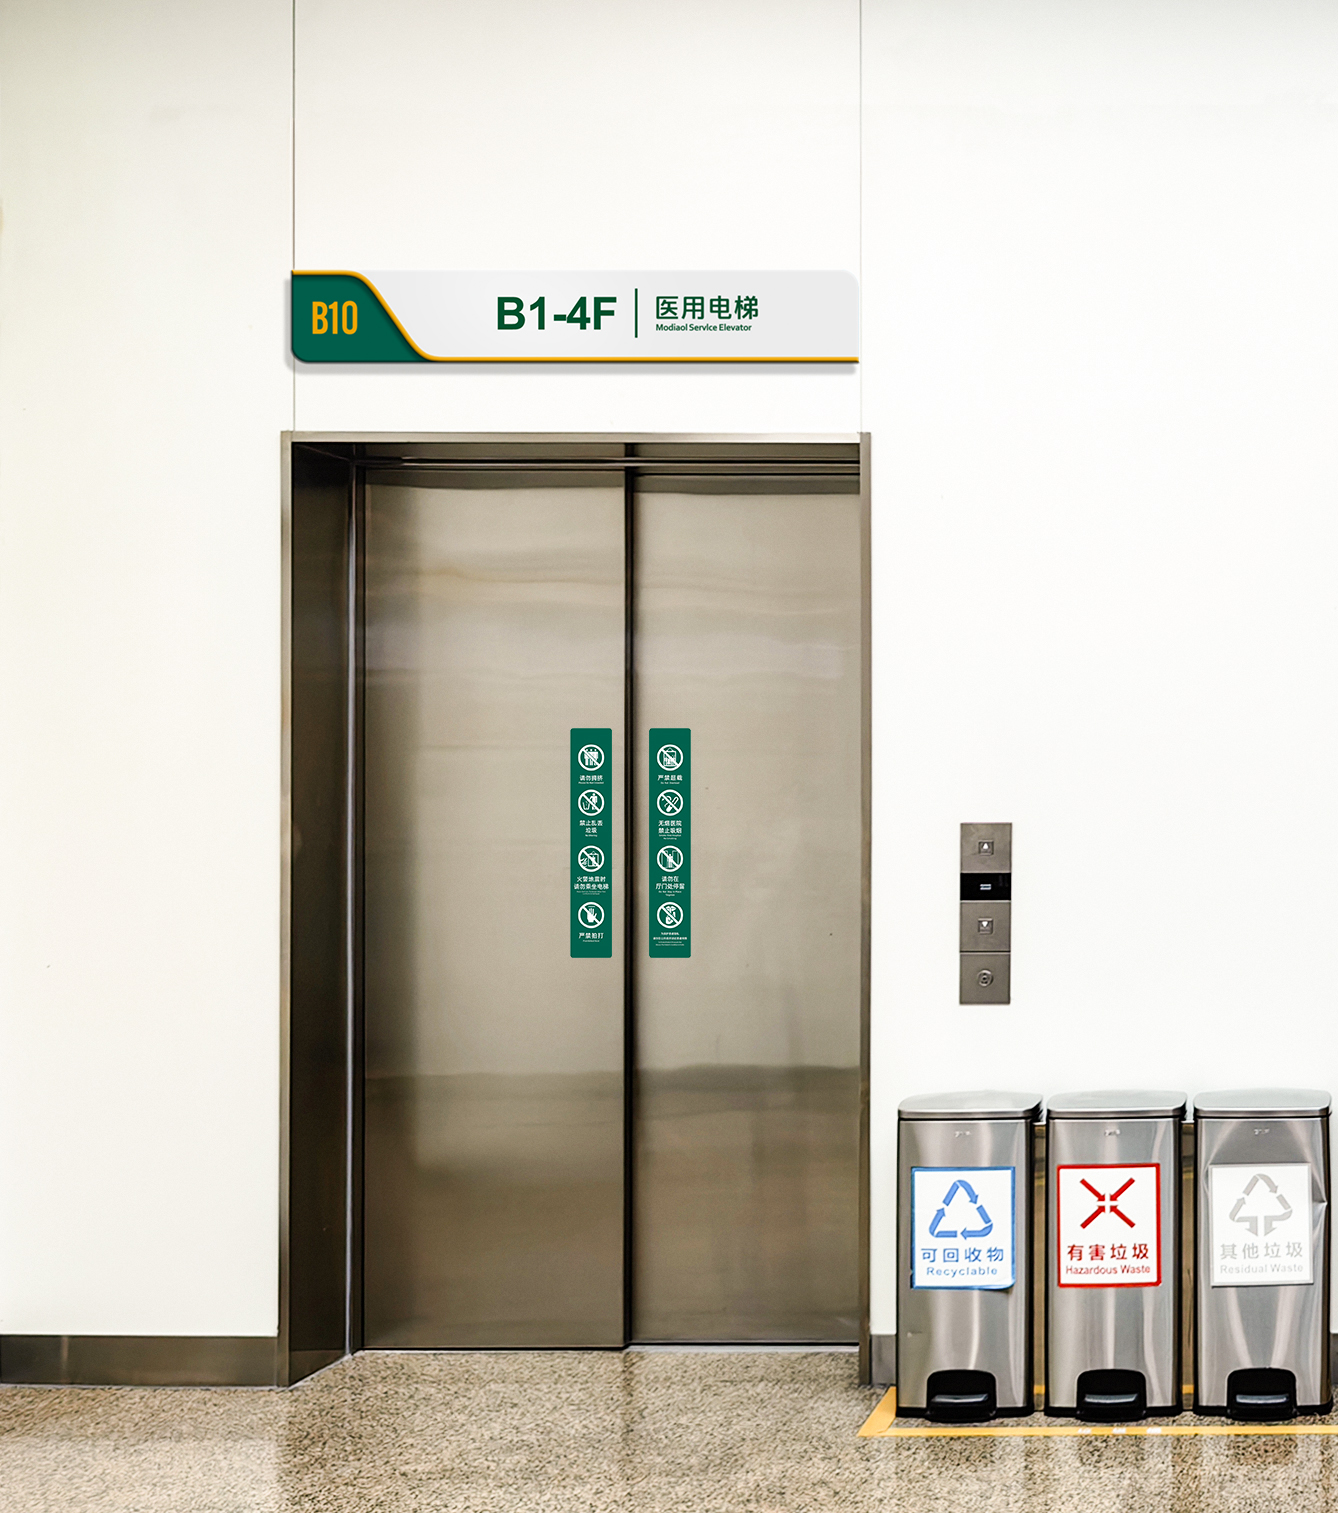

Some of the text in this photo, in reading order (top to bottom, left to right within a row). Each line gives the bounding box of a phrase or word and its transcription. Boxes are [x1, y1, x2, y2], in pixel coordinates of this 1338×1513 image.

[498, 297, 617, 330] B1-4F
[656, 296, 758, 319] 医用电梯
[312, 301, 357, 334] B10
[921, 1247, 1003, 1262] 可回收物
[1068, 1244, 1148, 1261] 有害垃圾
[1221, 1242, 1302, 1260] 其他垃圾
[927, 1267, 997, 1278] Recyclable
[1066, 1265, 1150, 1274] Hazardous Waste
[1220, 1264, 1303, 1274] Residual Waste
